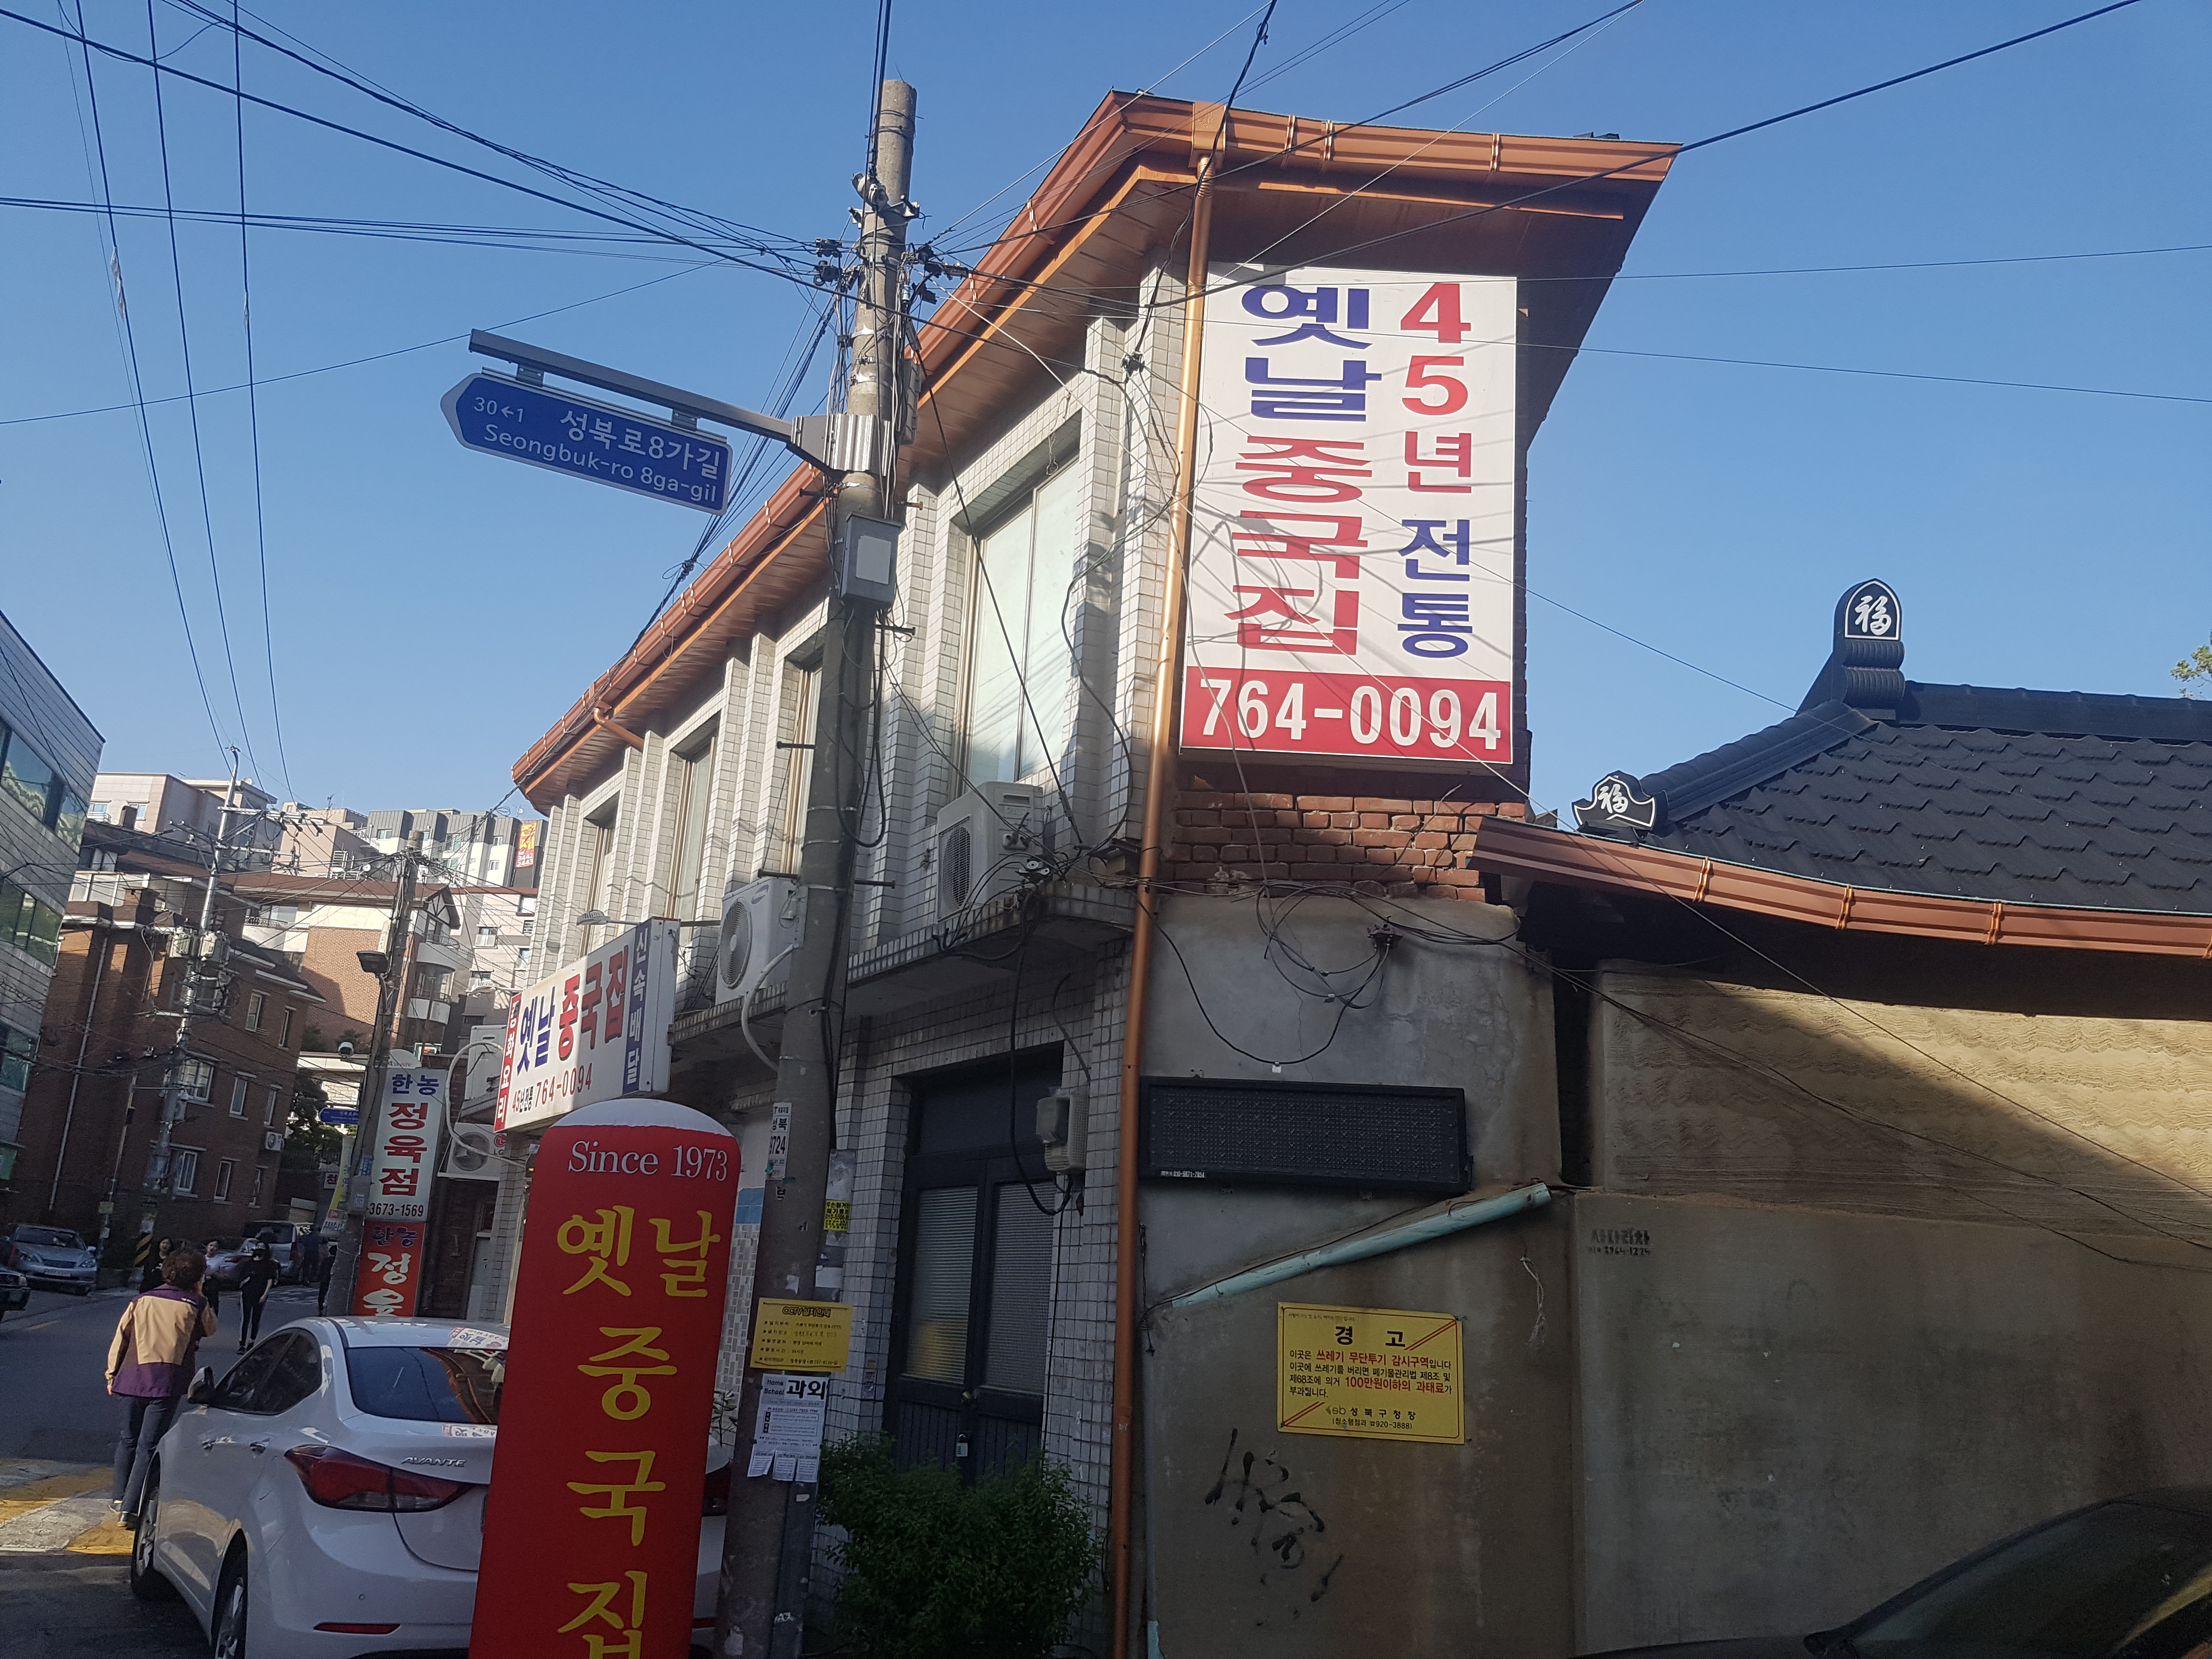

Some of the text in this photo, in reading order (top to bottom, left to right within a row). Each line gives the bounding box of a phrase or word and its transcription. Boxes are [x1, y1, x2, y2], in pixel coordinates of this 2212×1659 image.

[560, 409, 721, 480] 성북로8가길
[484, 424, 716, 503] Seongbuk-ro 8ga-gil
[1854, 595, 1892, 636] 福
[1200, 677, 1502, 751] 764-0094
[1597, 783, 1629, 814] 福
[627, 927, 649, 1085] 신속배달
[392, 1074, 439, 1096] 한농
[534, 1063, 592, 1108] 764-0094
[379, 1102, 430, 1197] 정육점
[567, 1140, 729, 1182] Since 1973
[369, 1203, 424, 1217] 3673-1569
[370, 1226, 419, 1248] 한농
[556, 1205, 721, 1298] 옛날
[1290, 1350, 1451, 1370] 이곳은 쓰레기 무단투기 감시구역입니다
[1290, 1362, 1312, 1372] 이곳에
[1314, 1363, 1344, 1374] 쓰레기를
[1347, 1365, 1369, 1376] 버리면
[1420, 1370, 1440, 1381] 제8조
[1443, 1372, 1451, 1382] 및
[786, 1380, 826, 1400] 과외
[1289, 1386, 1329, 1398] 부과됩니다.
[1290, 1374, 1452, 1395] 제68조에 의거 100만원이하의 과태료가
[401, 1456, 467, 1468] AVANTE
